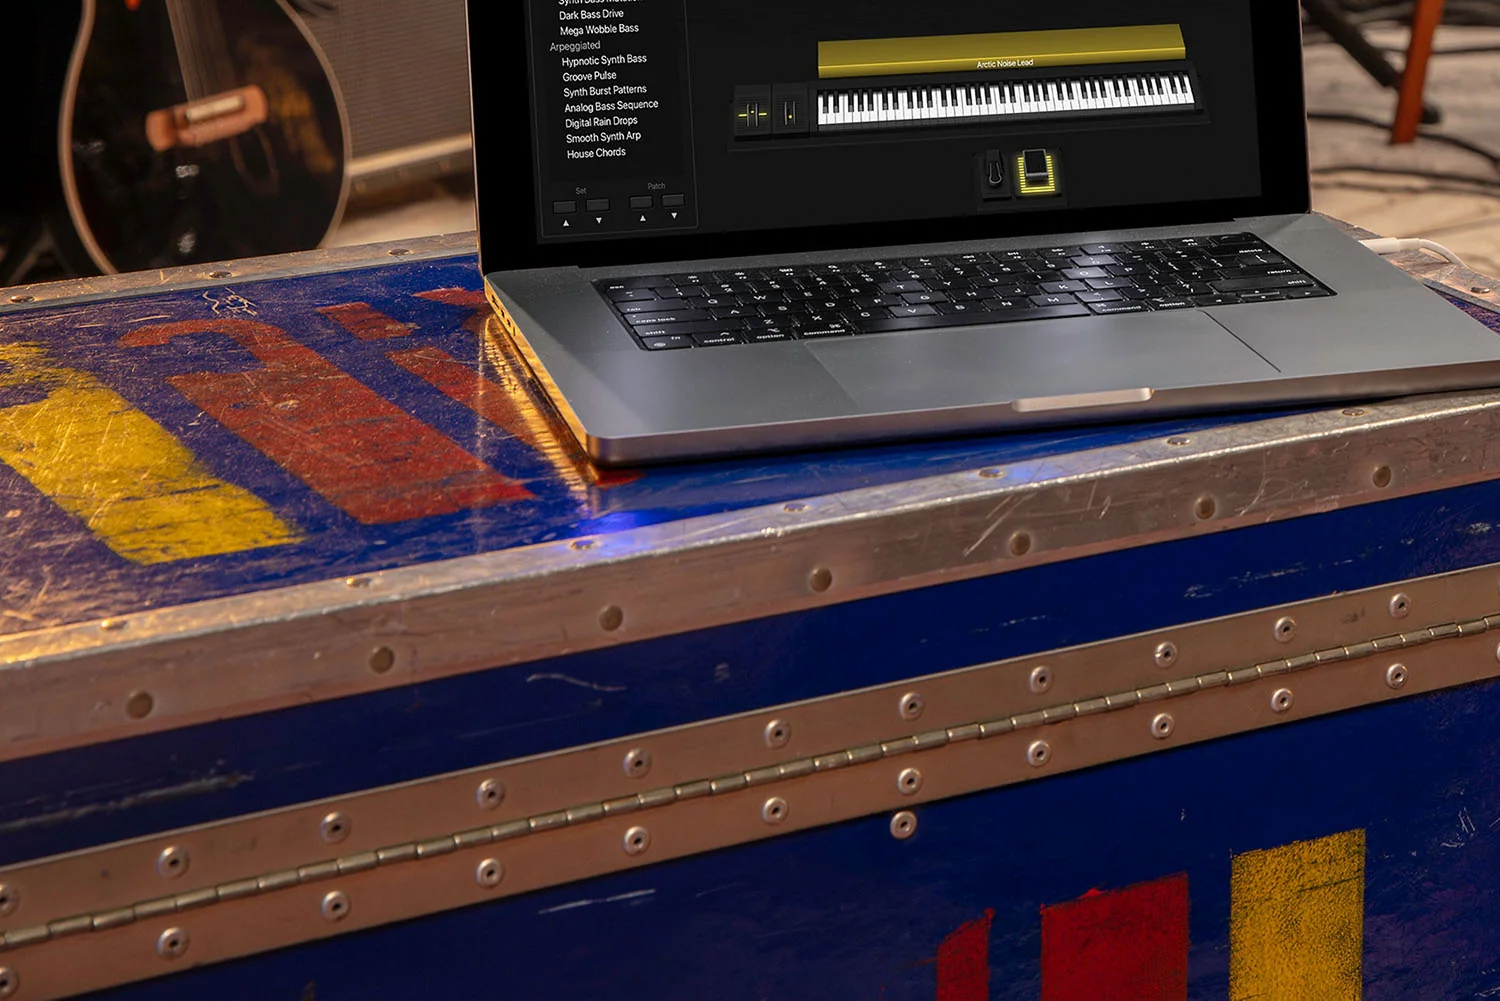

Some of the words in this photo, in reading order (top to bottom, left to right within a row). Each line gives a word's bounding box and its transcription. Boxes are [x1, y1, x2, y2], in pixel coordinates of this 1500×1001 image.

[559, 11, 579, 20] Dark
[580, 10, 601, 20] Bass
[602, 9, 624, 18] Drive
[560, 26, 584, 37] Mega
[585, 24, 617, 34] Wobble
[618, 23, 639, 33] Bass
[549, 40, 601, 53] Arpeggiated
[562, 56, 600, 68] Hypnotic
[601, 54, 626, 66] Synth
[627, 54, 647, 63] Bass
[976, 61, 996, 69] Arctic
[996, 59, 1017, 68] Noise
[1016, 58, 1034, 67] Lead
[562, 72, 593, 82] Groove
[594, 70, 617, 80] Pulse
[563, 87, 588, 99] Synth
[589, 86, 612, 96] Burst
[613, 85, 647, 94] Patterns
[564, 103, 594, 114] Analog
[595, 102, 616, 111] Bass
[617, 100, 659, 110] Sequence
[565, 118, 592, 130] Digital
[593, 117, 612, 126] Rain
[613, 116, 638, 126] Drops
[566, 133, 599, 144] Smooth
[600, 131, 625, 143] Synth
[626, 131, 642, 141] Arp
[567, 150, 594, 159] House
[596, 147, 626, 157] Chords
[575, 186, 587, 195] Set
[647, 182, 666, 190] Patch
